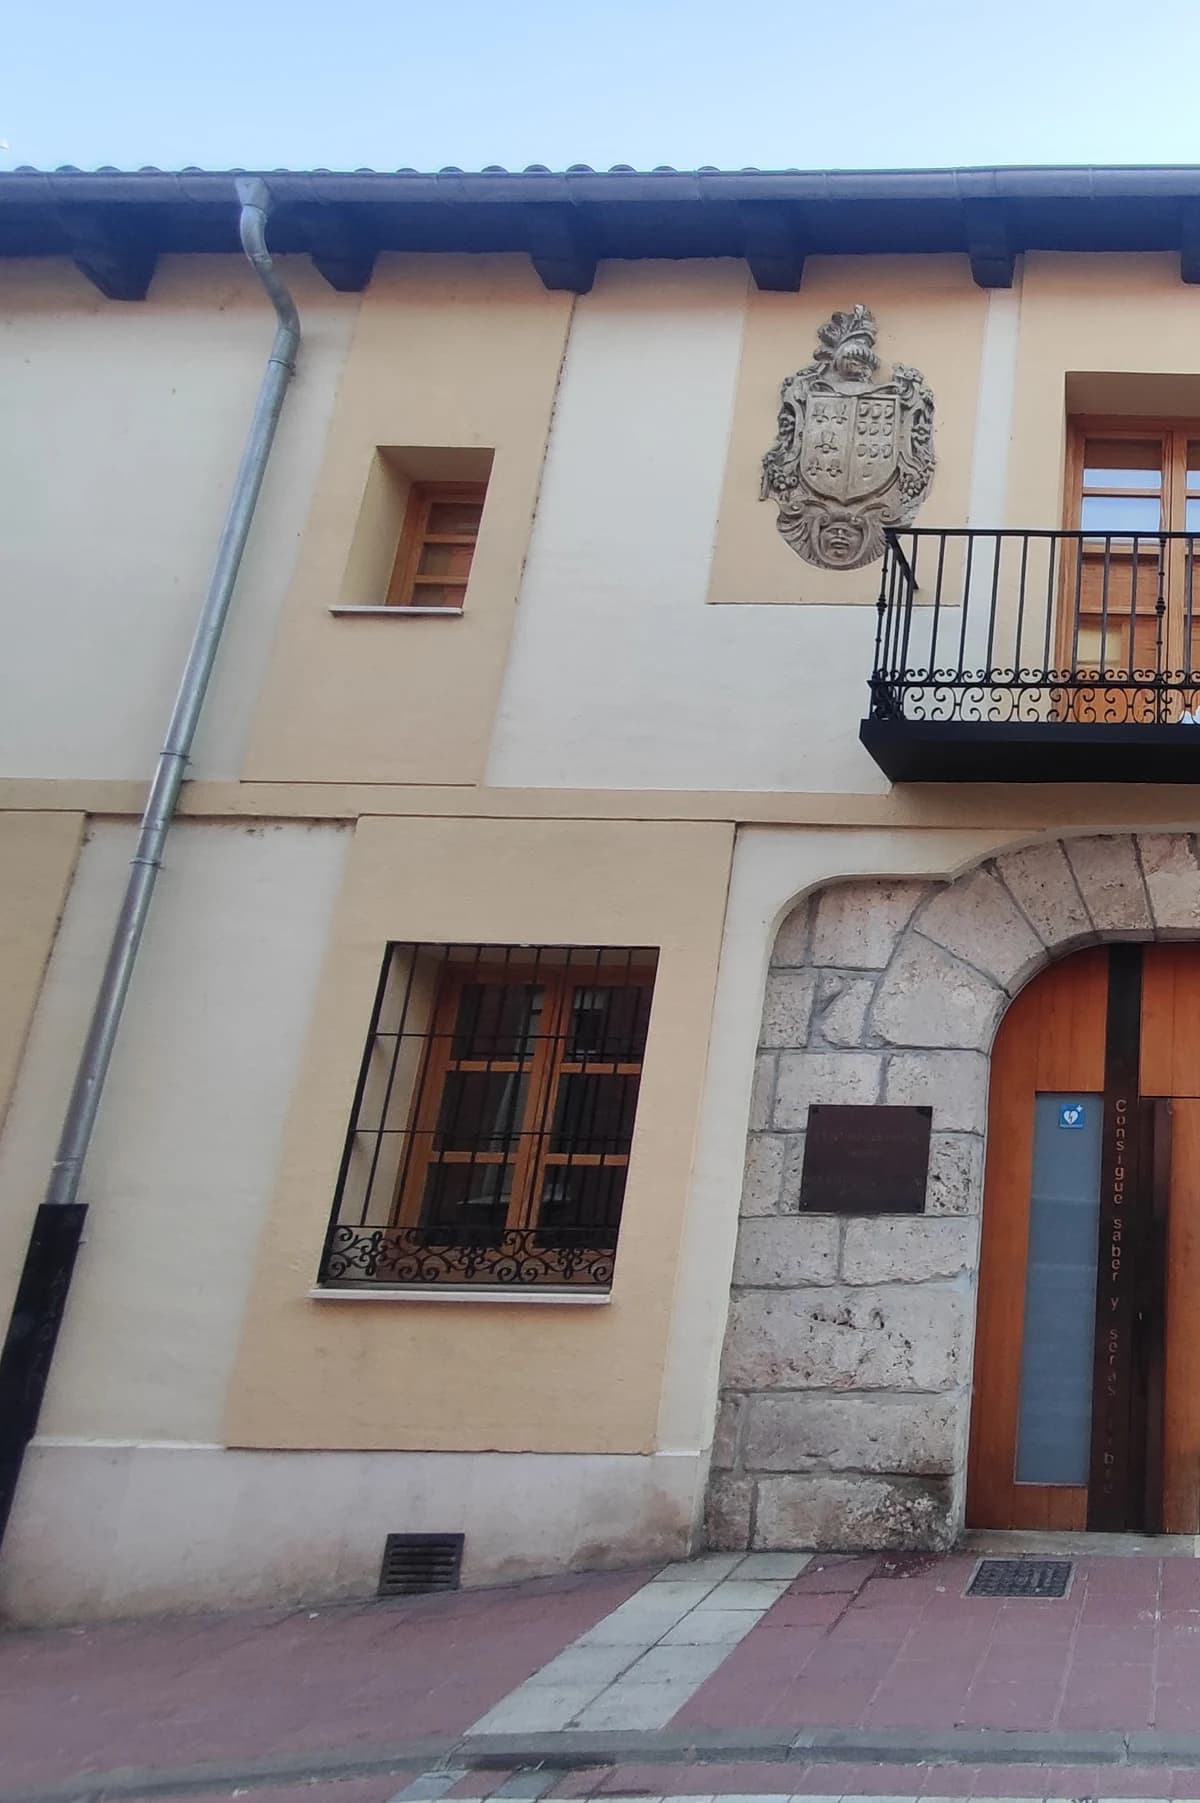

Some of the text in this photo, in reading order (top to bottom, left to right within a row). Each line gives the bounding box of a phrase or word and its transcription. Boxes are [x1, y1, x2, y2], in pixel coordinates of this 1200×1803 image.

[1114, 1099, 1127, 1205] Consigue
[1111, 1218, 1122, 1281] saber
[1111, 1297, 1119, 1311] y
